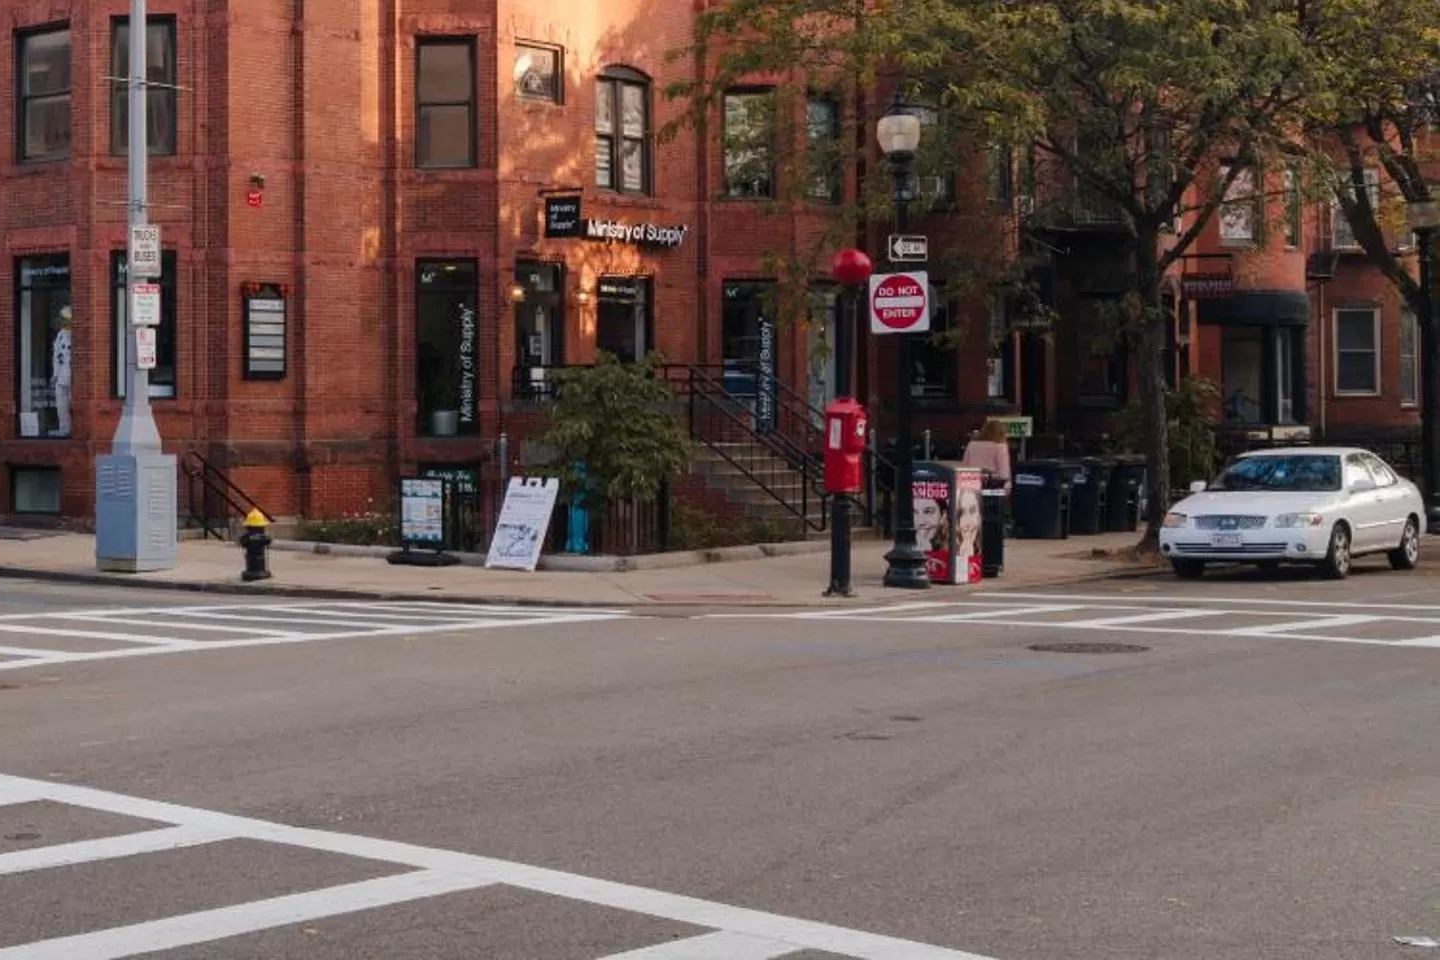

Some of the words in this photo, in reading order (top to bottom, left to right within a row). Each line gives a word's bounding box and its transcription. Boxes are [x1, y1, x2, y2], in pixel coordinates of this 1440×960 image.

[587, 218, 633, 243] Ministry
[633, 224, 645, 240] of
[879, 287, 894, 296] DO
[898, 285, 918, 295] NOT
[882, 308, 916, 318] ENTER
[461, 355, 472, 369] of
[461, 372, 474, 422] Ministry
